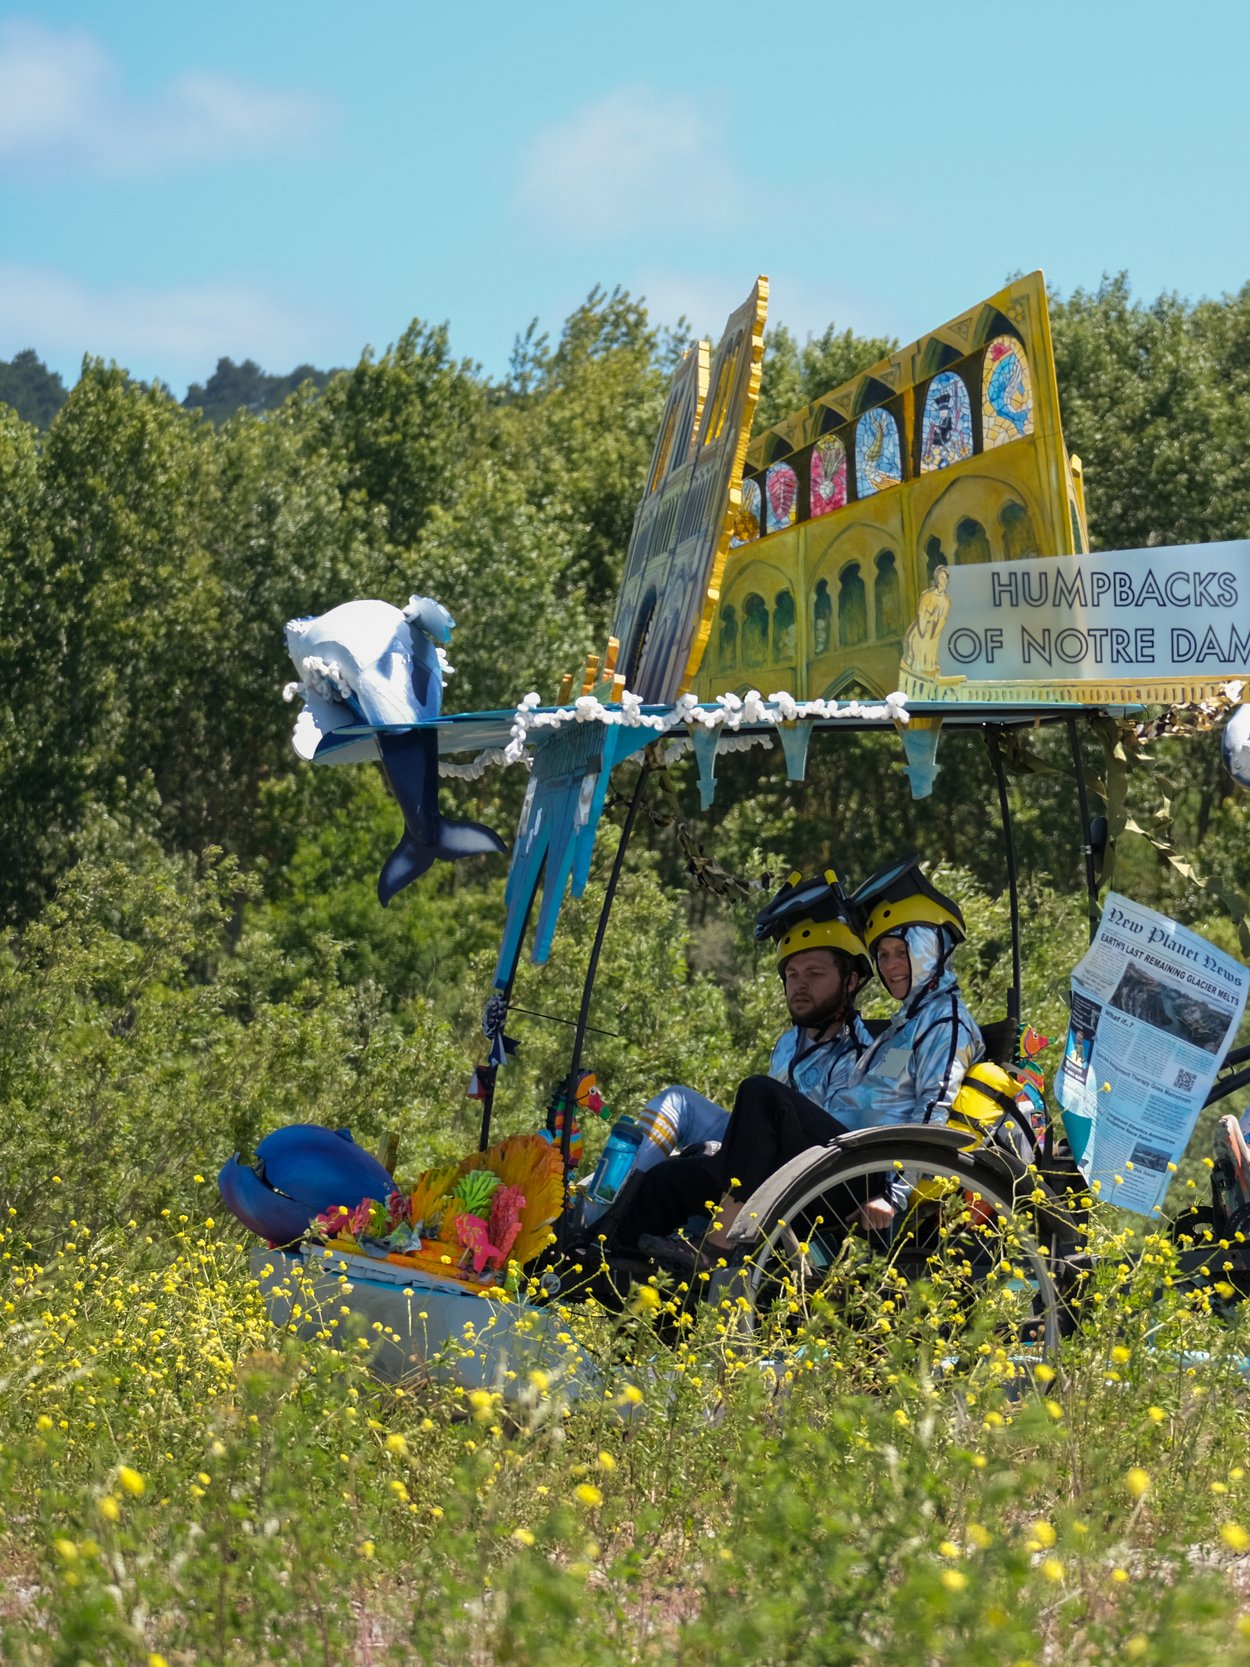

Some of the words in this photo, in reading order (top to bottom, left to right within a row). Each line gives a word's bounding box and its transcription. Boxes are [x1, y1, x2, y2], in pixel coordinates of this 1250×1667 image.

[991, 566, 1239, 608] HUMPBACKS
[948, 627, 1004, 665] OF
[1020, 624, 1156, 668] NOTRE
[1100, 932, 1125, 951] EARTH'S
[1125, 943, 1144, 960] LAST
[1144, 954, 1186, 980] REMAINING
[1186, 974, 1217, 995] GLACIER
[1217, 988, 1239, 1006] MELTS
[1108, 907, 1144, 934] New
[1148, 926, 1200, 963] Planet
[1202, 954, 1243, 987] News
[1104, 1009, 1122, 1024] What
